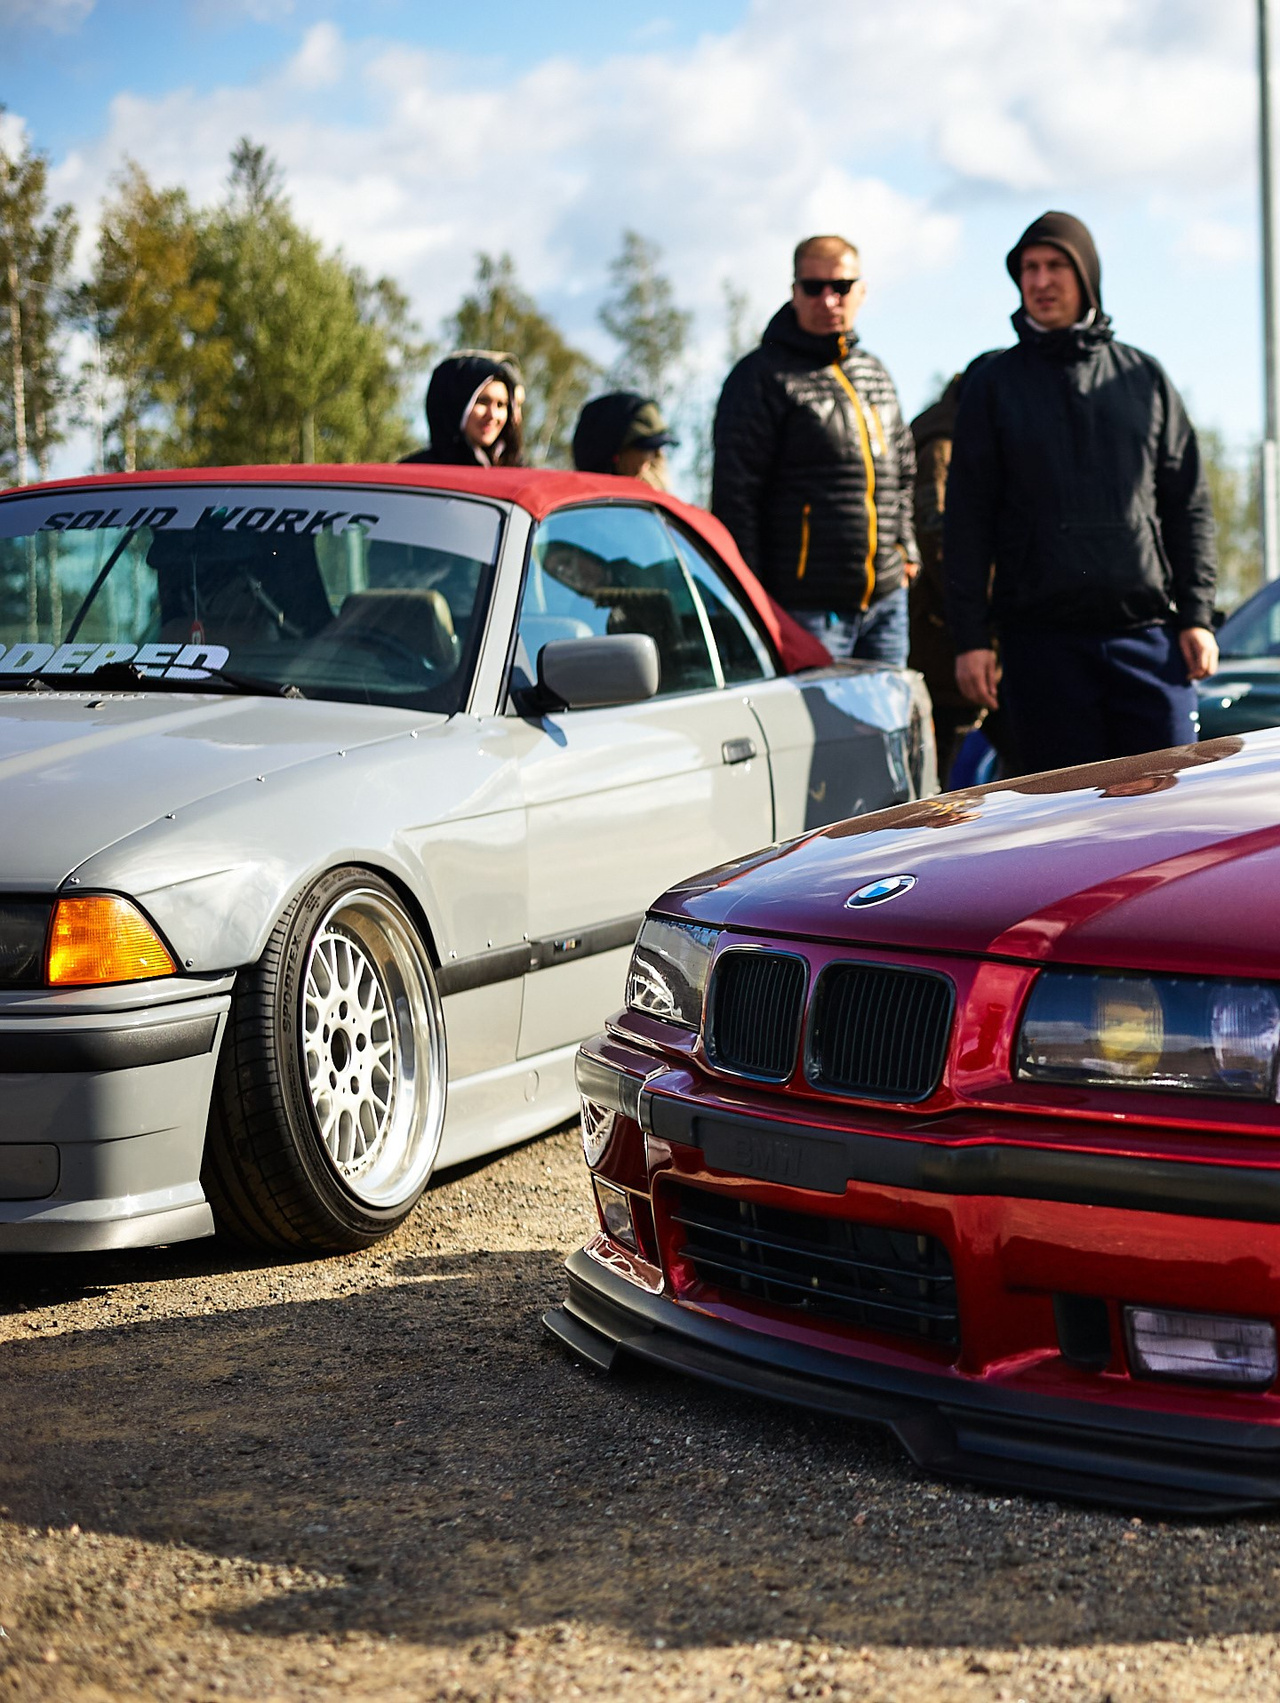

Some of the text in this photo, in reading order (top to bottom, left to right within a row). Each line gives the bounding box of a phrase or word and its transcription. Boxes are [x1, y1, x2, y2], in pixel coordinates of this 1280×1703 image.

[38, 505, 380, 534] SOLID WORKS
[0, 643, 230, 680] DERED
